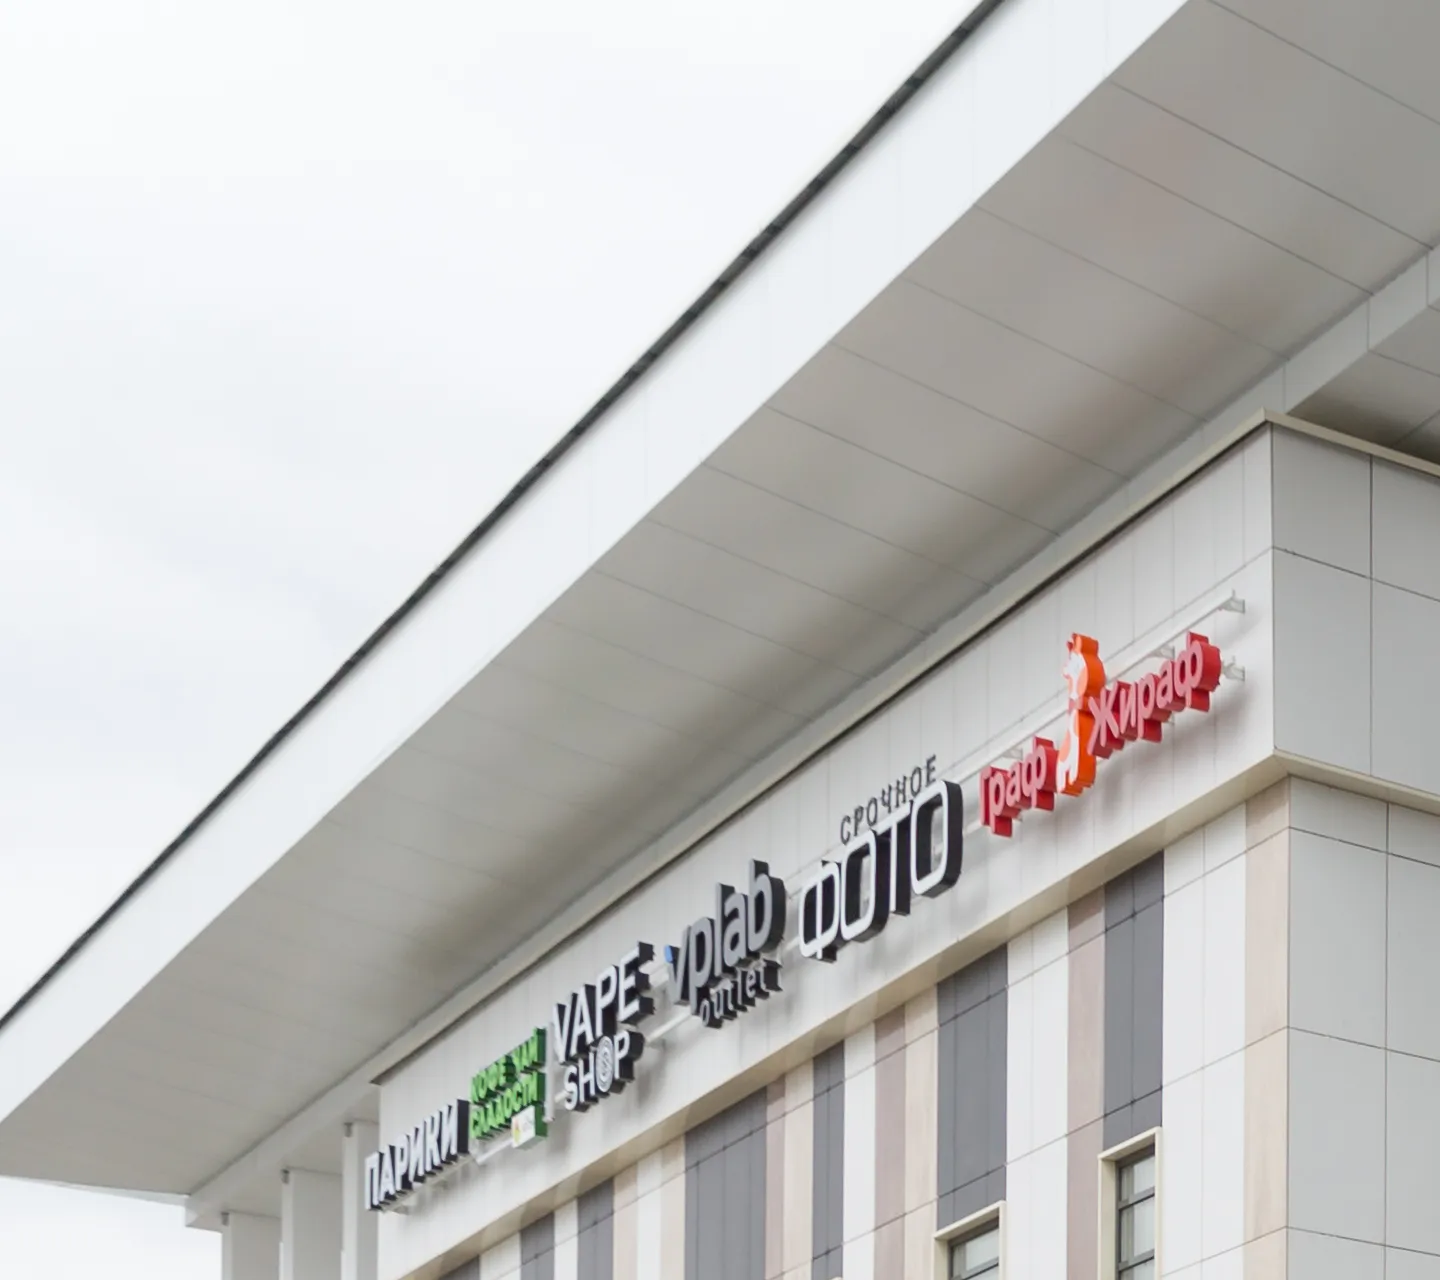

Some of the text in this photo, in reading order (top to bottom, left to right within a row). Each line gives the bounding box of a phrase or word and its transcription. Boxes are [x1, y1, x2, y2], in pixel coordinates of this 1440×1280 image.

[1087, 631, 1221, 758] Жираф
[839, 753, 938, 845] СРОЧНОЕ
[798, 779, 963, 965] ФОТО
[664, 858, 787, 1016] vplab
[554, 940, 654, 1065] VAPE
[563, 1029, 645, 1112] SHOP
[365, 1099, 468, 1211] ПАРИКИ
